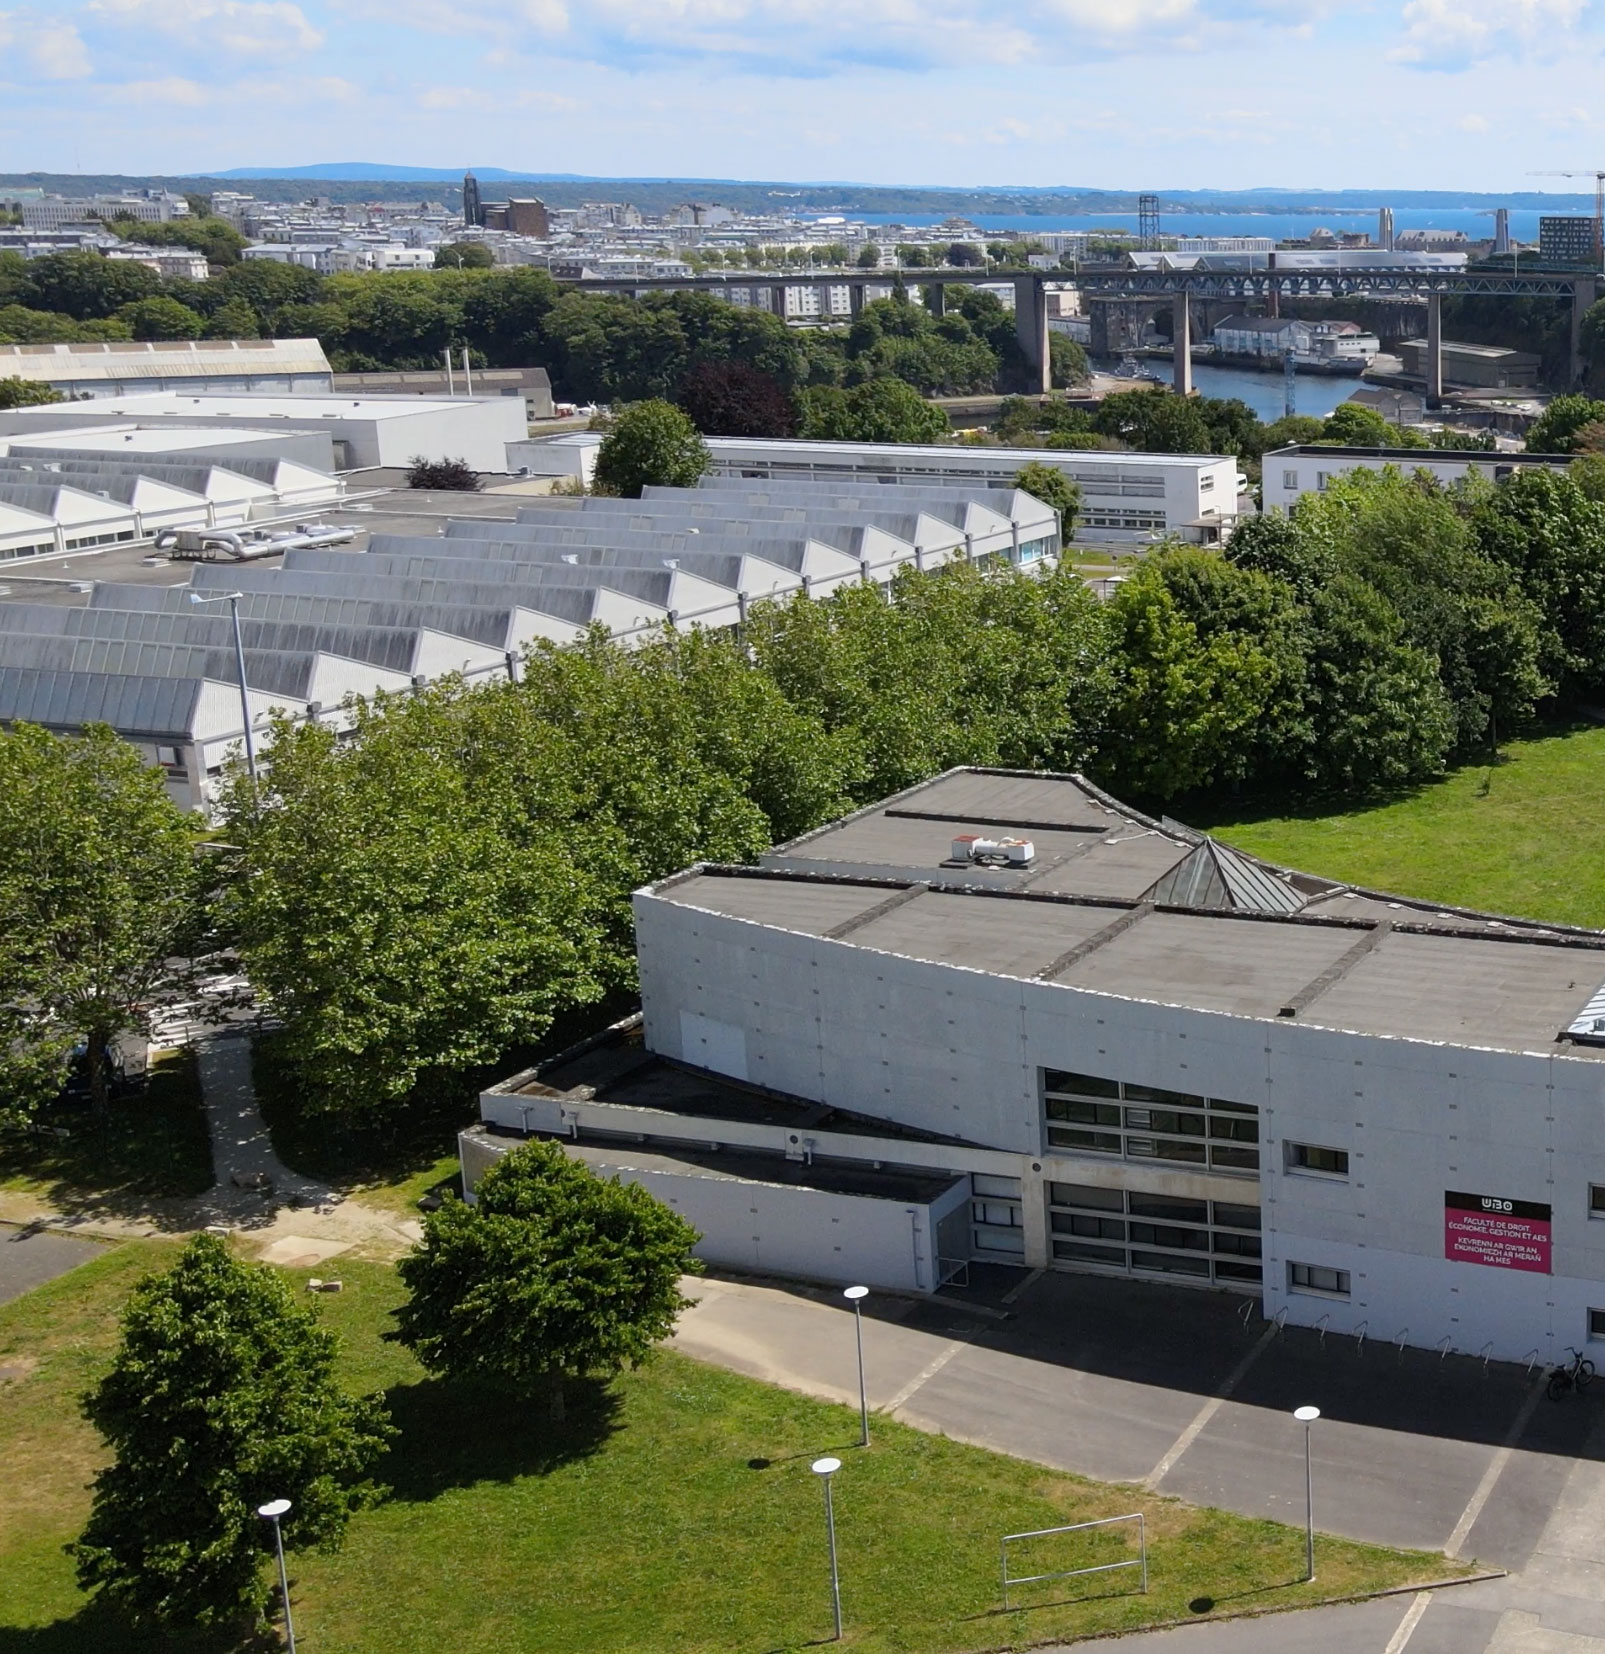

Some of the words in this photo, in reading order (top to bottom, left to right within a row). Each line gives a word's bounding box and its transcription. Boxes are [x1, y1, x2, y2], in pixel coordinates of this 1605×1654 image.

[1482, 1198, 1512, 1211] UBO
[1464, 1216, 1495, 1228] FACULTÉ
[1489, 1228, 1521, 1238] GESTION
[1532, 1234, 1547, 1242] AES
[1458, 1237, 1492, 1248] KEVRENN
[1505, 1243, 1524, 1252] GWIR
